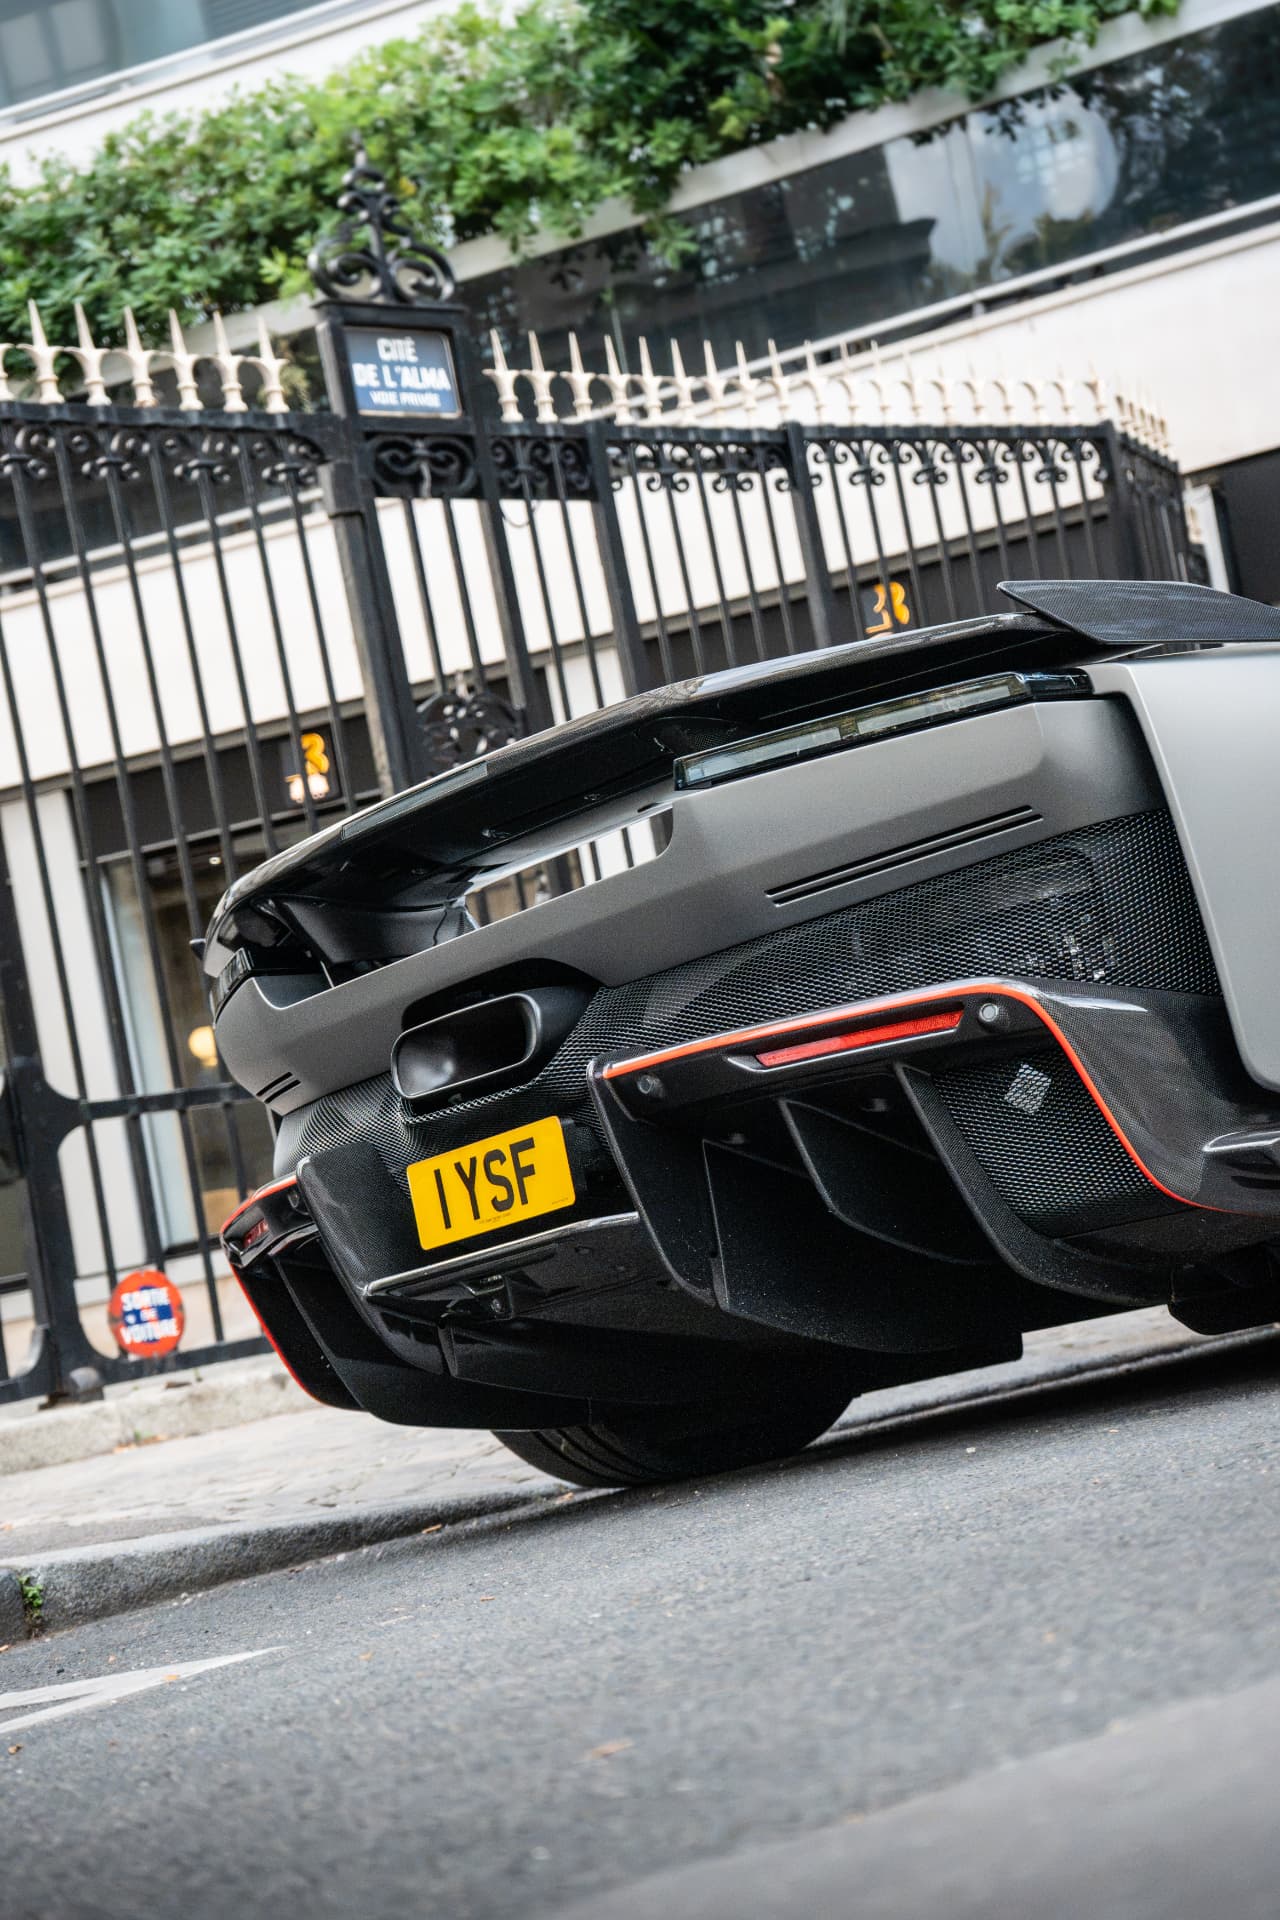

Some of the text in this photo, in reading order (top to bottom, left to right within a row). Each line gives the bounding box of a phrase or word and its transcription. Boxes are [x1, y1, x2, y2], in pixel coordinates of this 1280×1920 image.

[352, 363, 451, 391] DE L'ALMA
[454, 1137, 536, 1221] YSF
